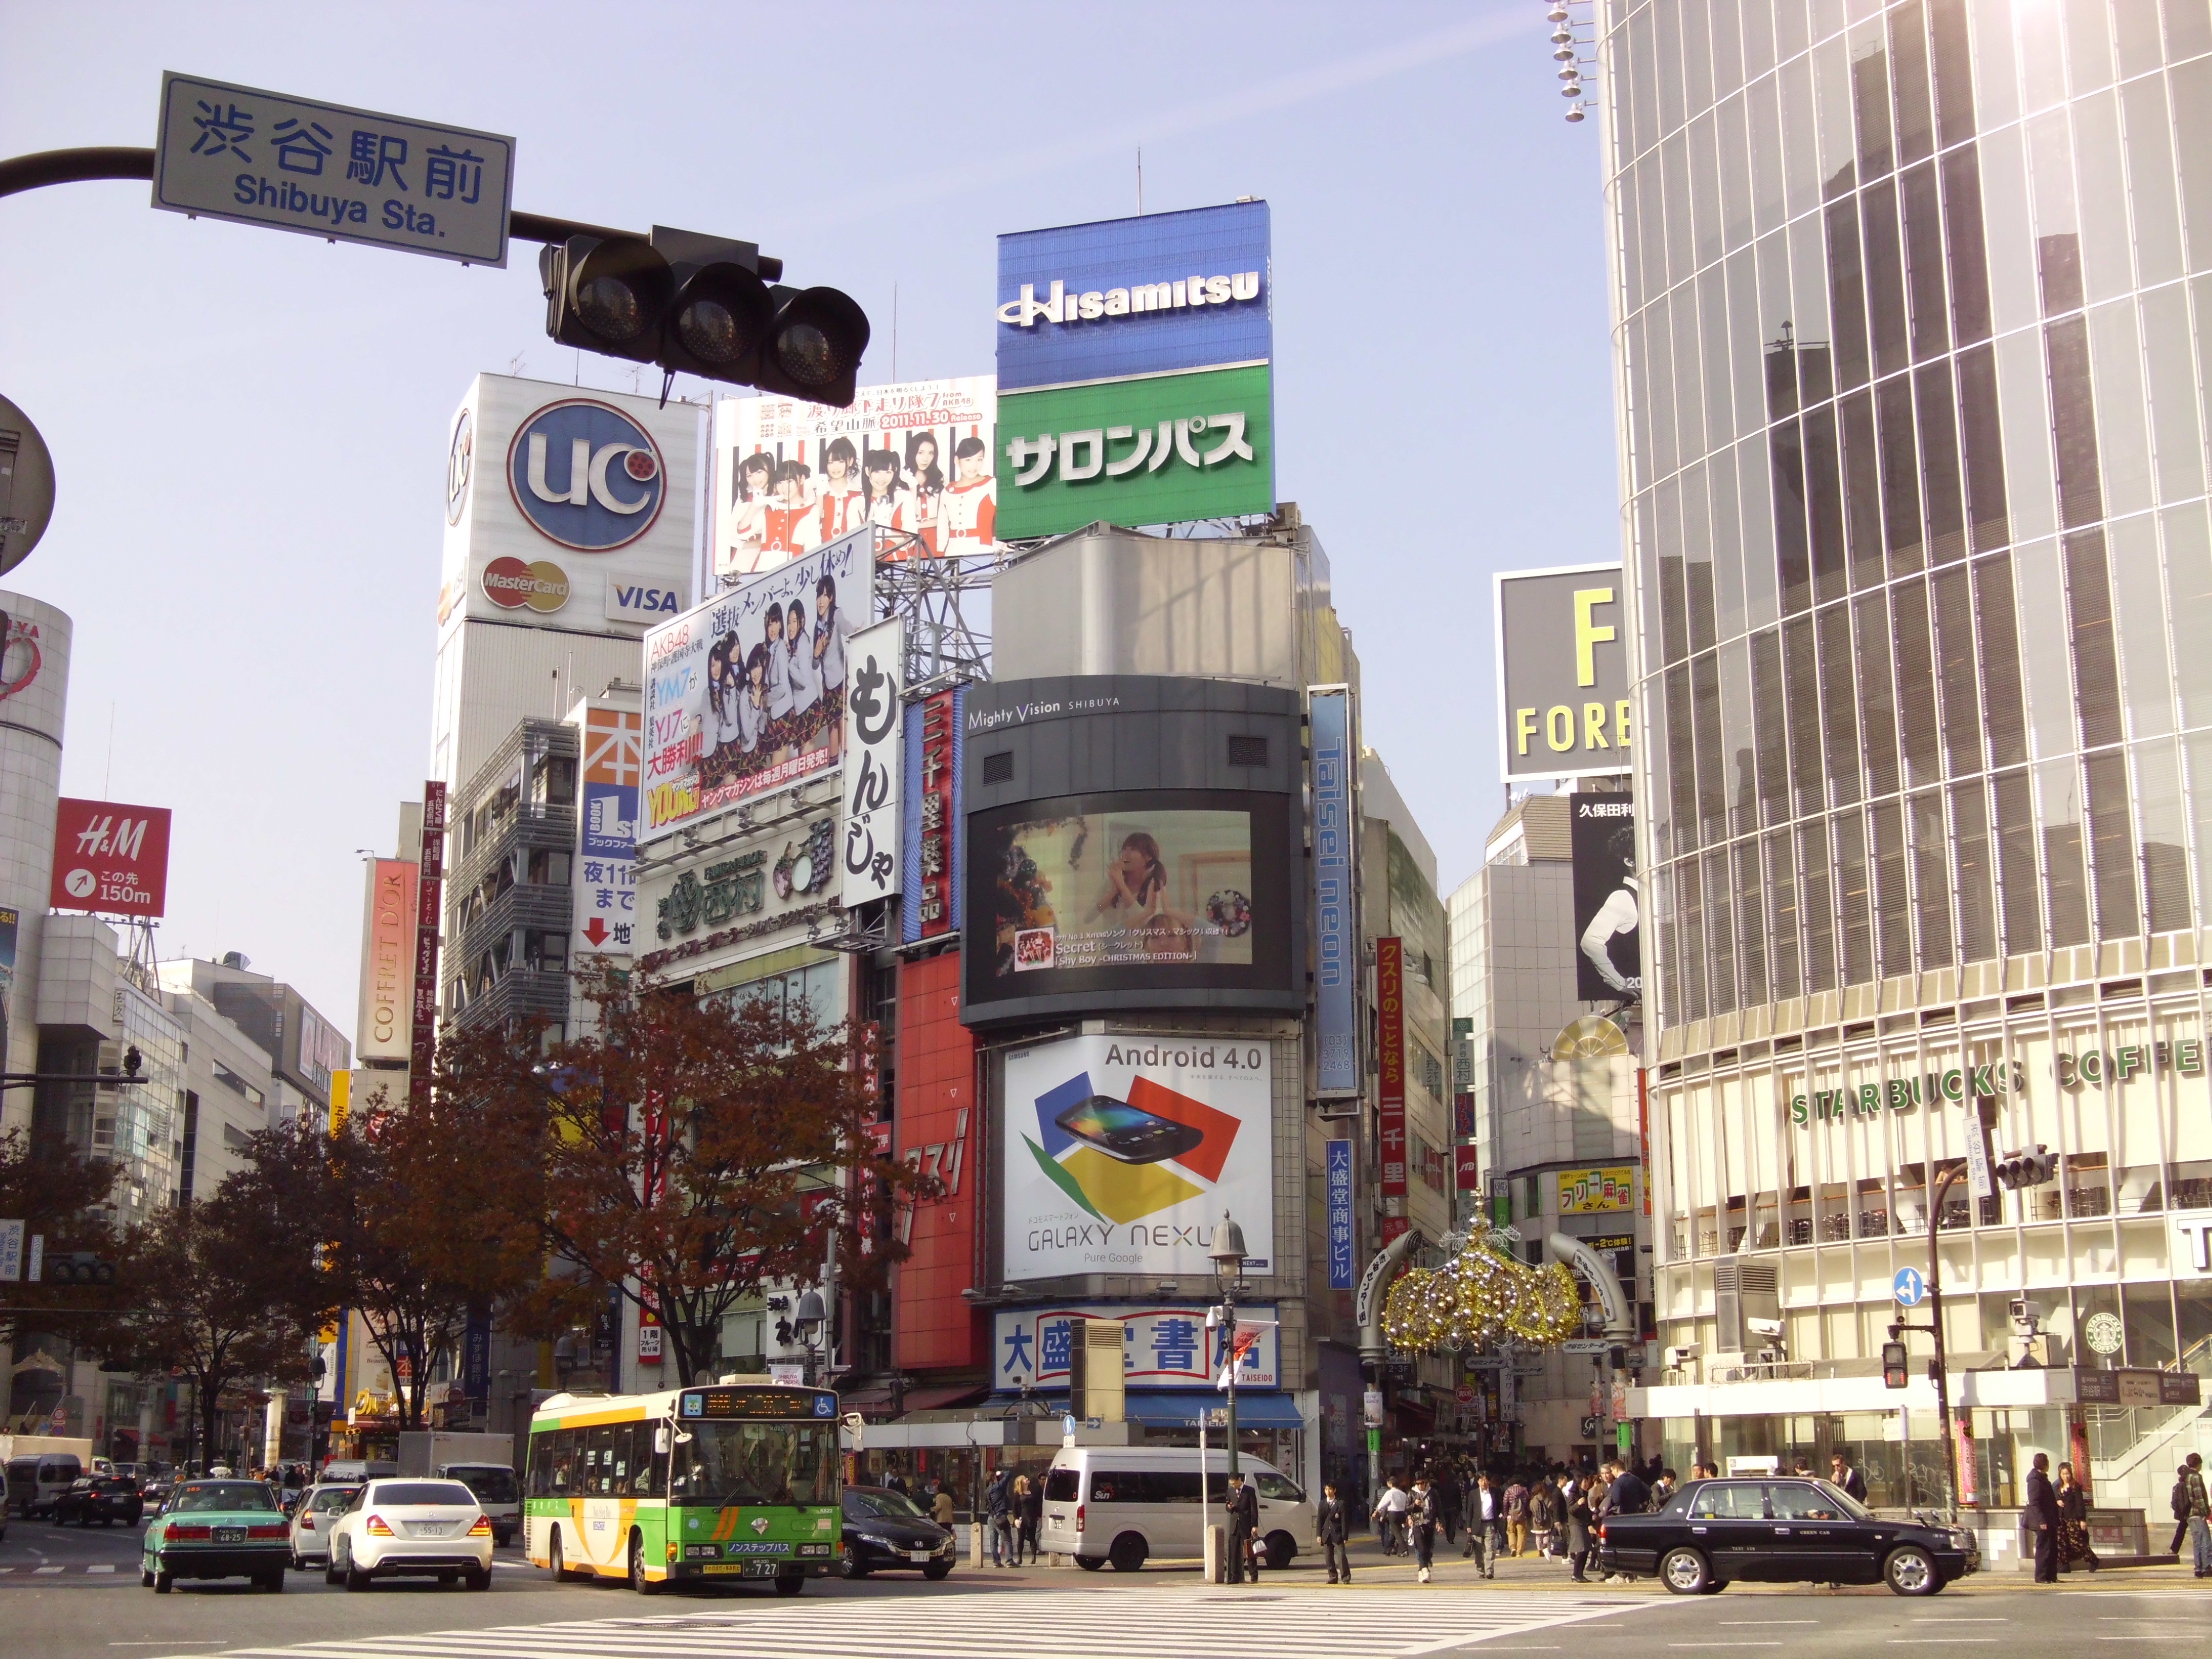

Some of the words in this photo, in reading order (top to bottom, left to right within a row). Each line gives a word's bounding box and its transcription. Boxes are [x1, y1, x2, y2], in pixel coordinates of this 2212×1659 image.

[190, 100, 484, 204] 渋谷駅前
[233, 173, 368, 224] Shibuya
[381, 199, 445, 238] Sta.
[995, 271, 1259, 327] Hisamitsu
[943, 397, 971, 406] AKB48
[814, 418, 877, 433] 希望山脈
[882, 411, 948, 428] 2011.11.30
[951, 413, 982, 422] Release
[1006, 412, 1252, 487] サロンパス
[484, 572, 569, 597] MasterCard
[614, 586, 677, 613] VISA
[650, 624, 689, 661] AKB48
[1573, 587, 1614, 687] F
[969, 708, 1013, 730] Mighty
[1016, 701, 1060, 722] Vision
[1069, 697, 1120, 710] SHIBUYA
[701, 748, 828, 809] ヤングマガジンは毎週月曜日発売!
[845, 654, 897, 891] もんじゃ
[646, 777, 701, 830] YOUNG
[920, 699, 945, 923] 三千里薬品
[1316, 737, 1345, 868] Taisei
[589, 800, 602, 833] BOOK
[77, 815, 147, 861] H&M
[101, 870, 139, 886] この先
[100, 884, 151, 904] 150m
[378, 873, 402, 927] D'OR
[596, 889, 634, 910] まで
[613, 922, 635, 945] 地
[1320, 879, 1341, 987] neon
[1056, 943, 1095, 954] Secret
[1079, 955, 1097, 966] Boy
[374, 937, 398, 1043] COFFRET
[1382, 945, 1398, 1083] クスリのことなら
[1324, 1034, 1347, 1047] (03)
[1324, 1048, 1349, 1059] 3719
[1008, 1051, 1030, 1061] SAMSUNG
[1105, 1044, 1216, 1069] Android
[1223, 1048, 1262, 1070] 4.0
[1323, 1059, 1350, 1071] 2468
[1457, 1058, 1470, 1081] 西村
[1791, 1059, 2025, 1125] STARBUCKS
[1382, 1096, 1405, 1183] 三千里
[1458, 1161, 1475, 1173] JTB
[1562, 1182, 1628, 1208] フリー麻雀
[1583, 1201, 1610, 1210] さん
[1029, 1213, 1079, 1224] ドコモスマートフォン
[1331, 1150, 1350, 1279] 大盛堂商事ビル
[5, 1225, 19, 1275] 渋谷駅前
[1029, 1224, 1115, 1251] GALAXY
[1085, 1253, 1106, 1263] Pure
[1109, 1253, 1143, 1265] Google
[1358, 1254, 1386, 1324] 渋谷センター街
[642, 1330, 658, 1338] 1階
[2088, 1315, 2121, 1333] STARBUCKS
[2092, 1340, 2119, 1352] COFFEE
[1241, 1374, 1272, 1382] TAISEIDO
[1094, 1491, 1110, 1499] Sun
[729, 1543, 790, 1552] ノンステップバス
